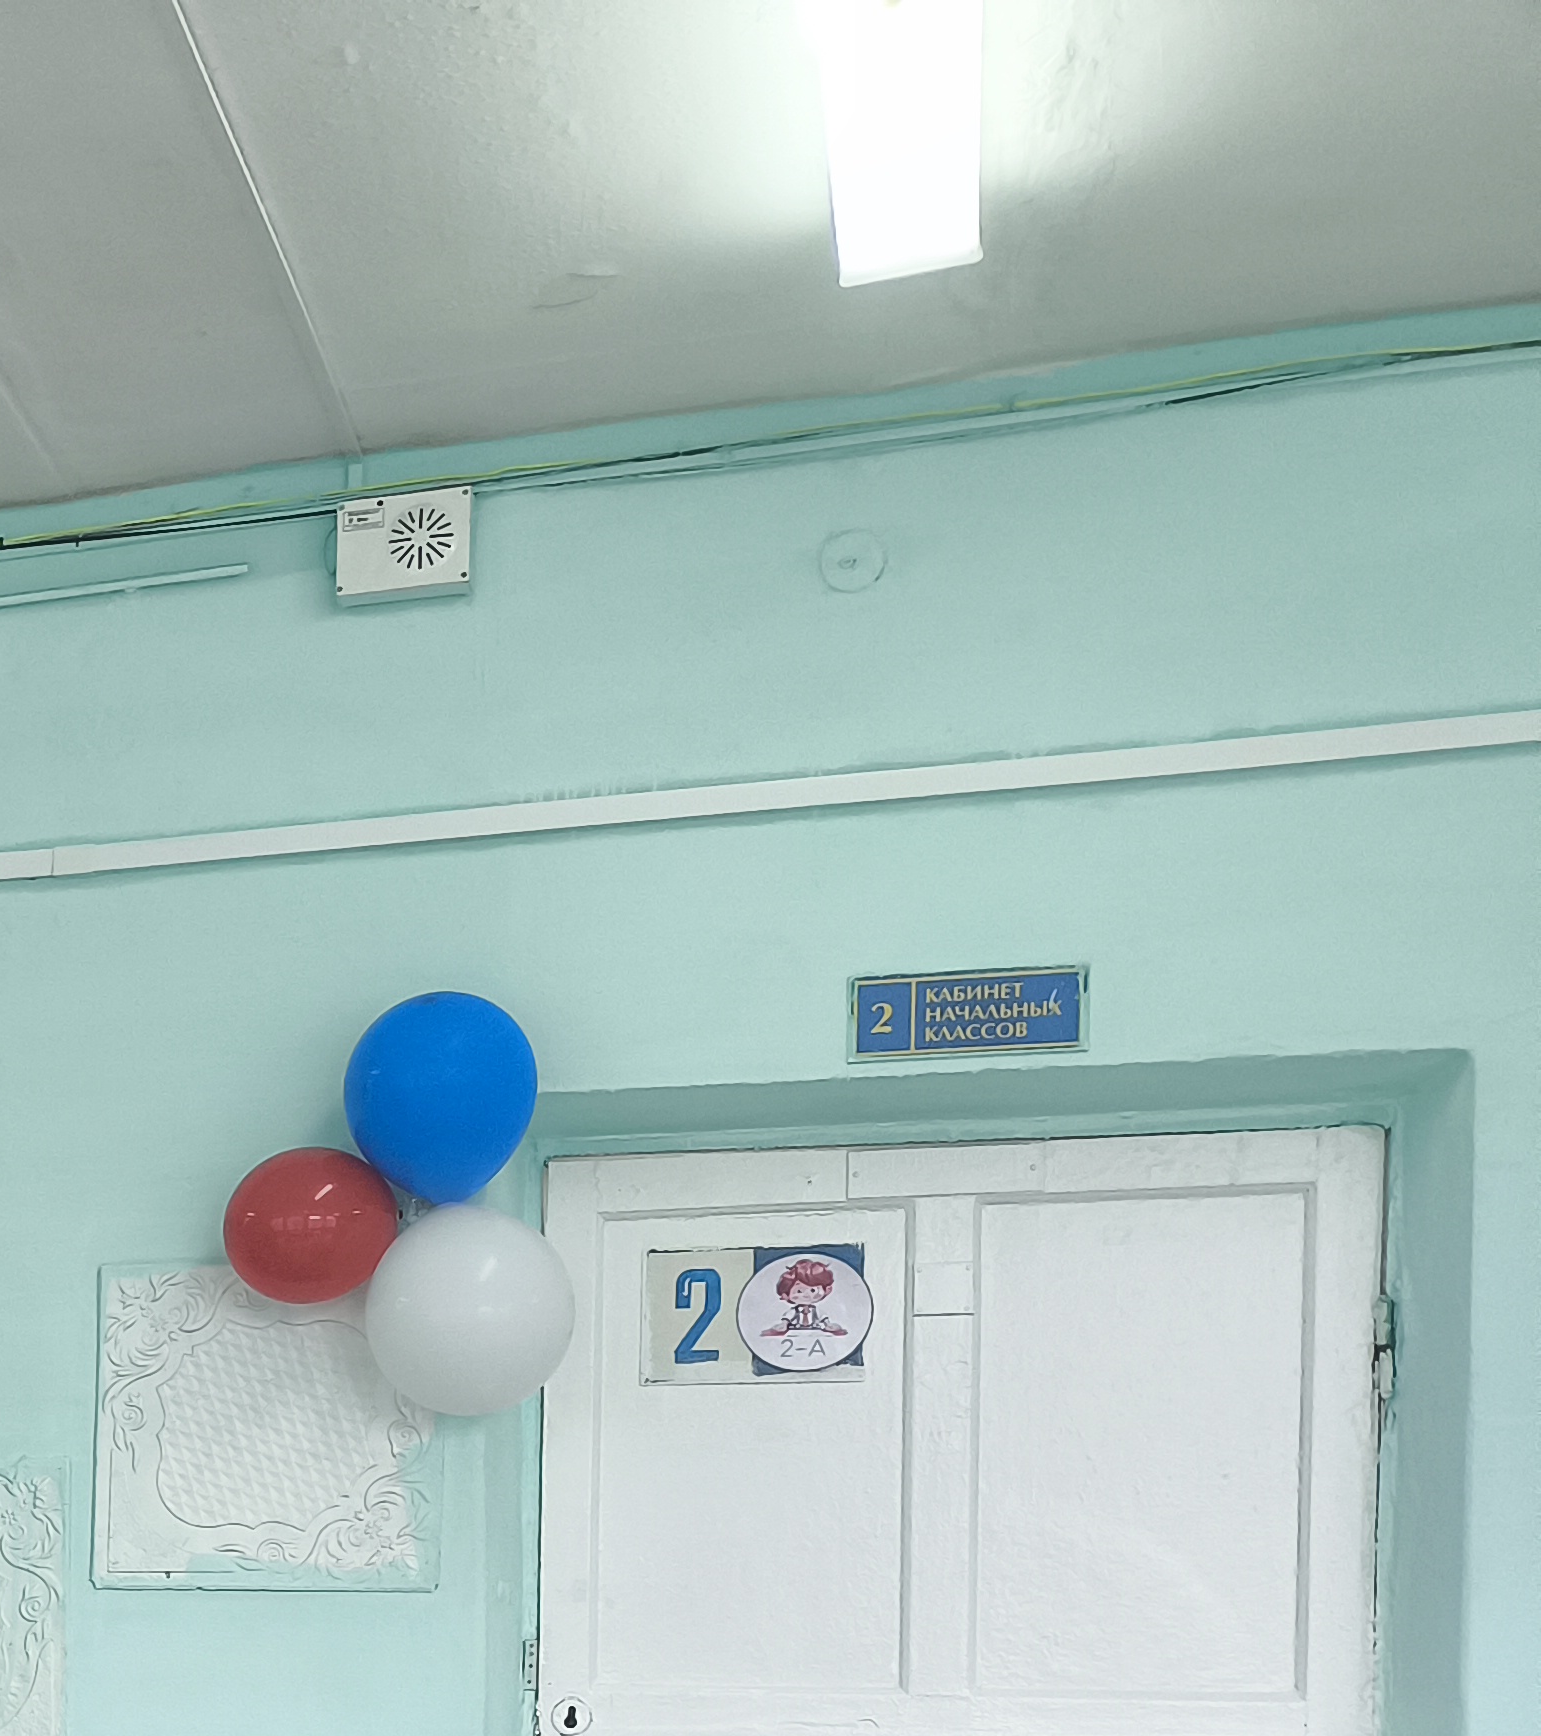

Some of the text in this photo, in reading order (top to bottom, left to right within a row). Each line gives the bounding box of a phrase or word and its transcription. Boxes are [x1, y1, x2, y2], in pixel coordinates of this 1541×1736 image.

[924, 982, 1024, 1004] КАБИНЕТ
[870, 1002, 893, 1035] 2
[924, 996, 1063, 1023] НАЧАЛЬНЫХ
[924, 1021, 1028, 1043] КЛАССОВ
[674, 1268, 722, 1364] 2
[780, 1338, 827, 1359] 2-А
